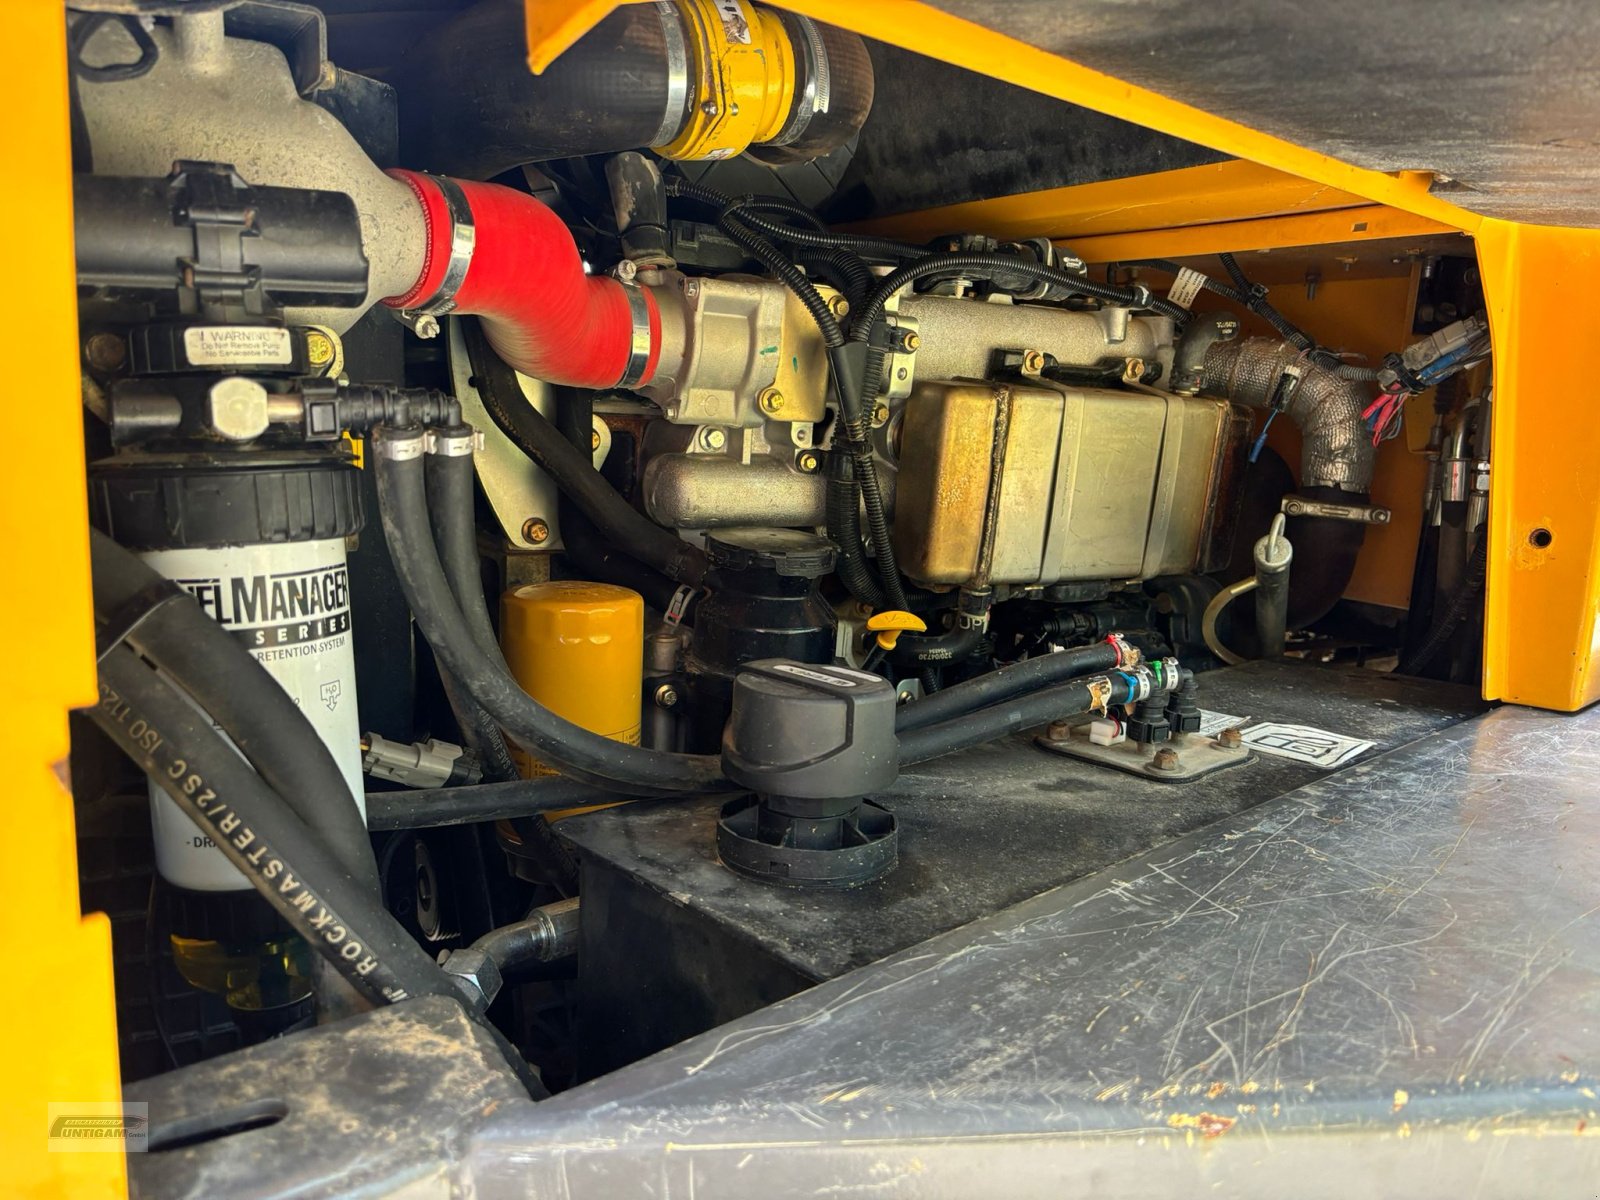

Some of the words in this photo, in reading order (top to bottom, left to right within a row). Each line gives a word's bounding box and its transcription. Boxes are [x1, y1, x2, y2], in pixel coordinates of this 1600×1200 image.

[255, 614, 347, 646] SERIES
[257, 642, 318, 663] RETENTION
[319, 636, 346, 653] SYSTEM
[128, 719, 164, 754] ISO
[167, 758, 378, 977] ROCKMASTER/2SC
